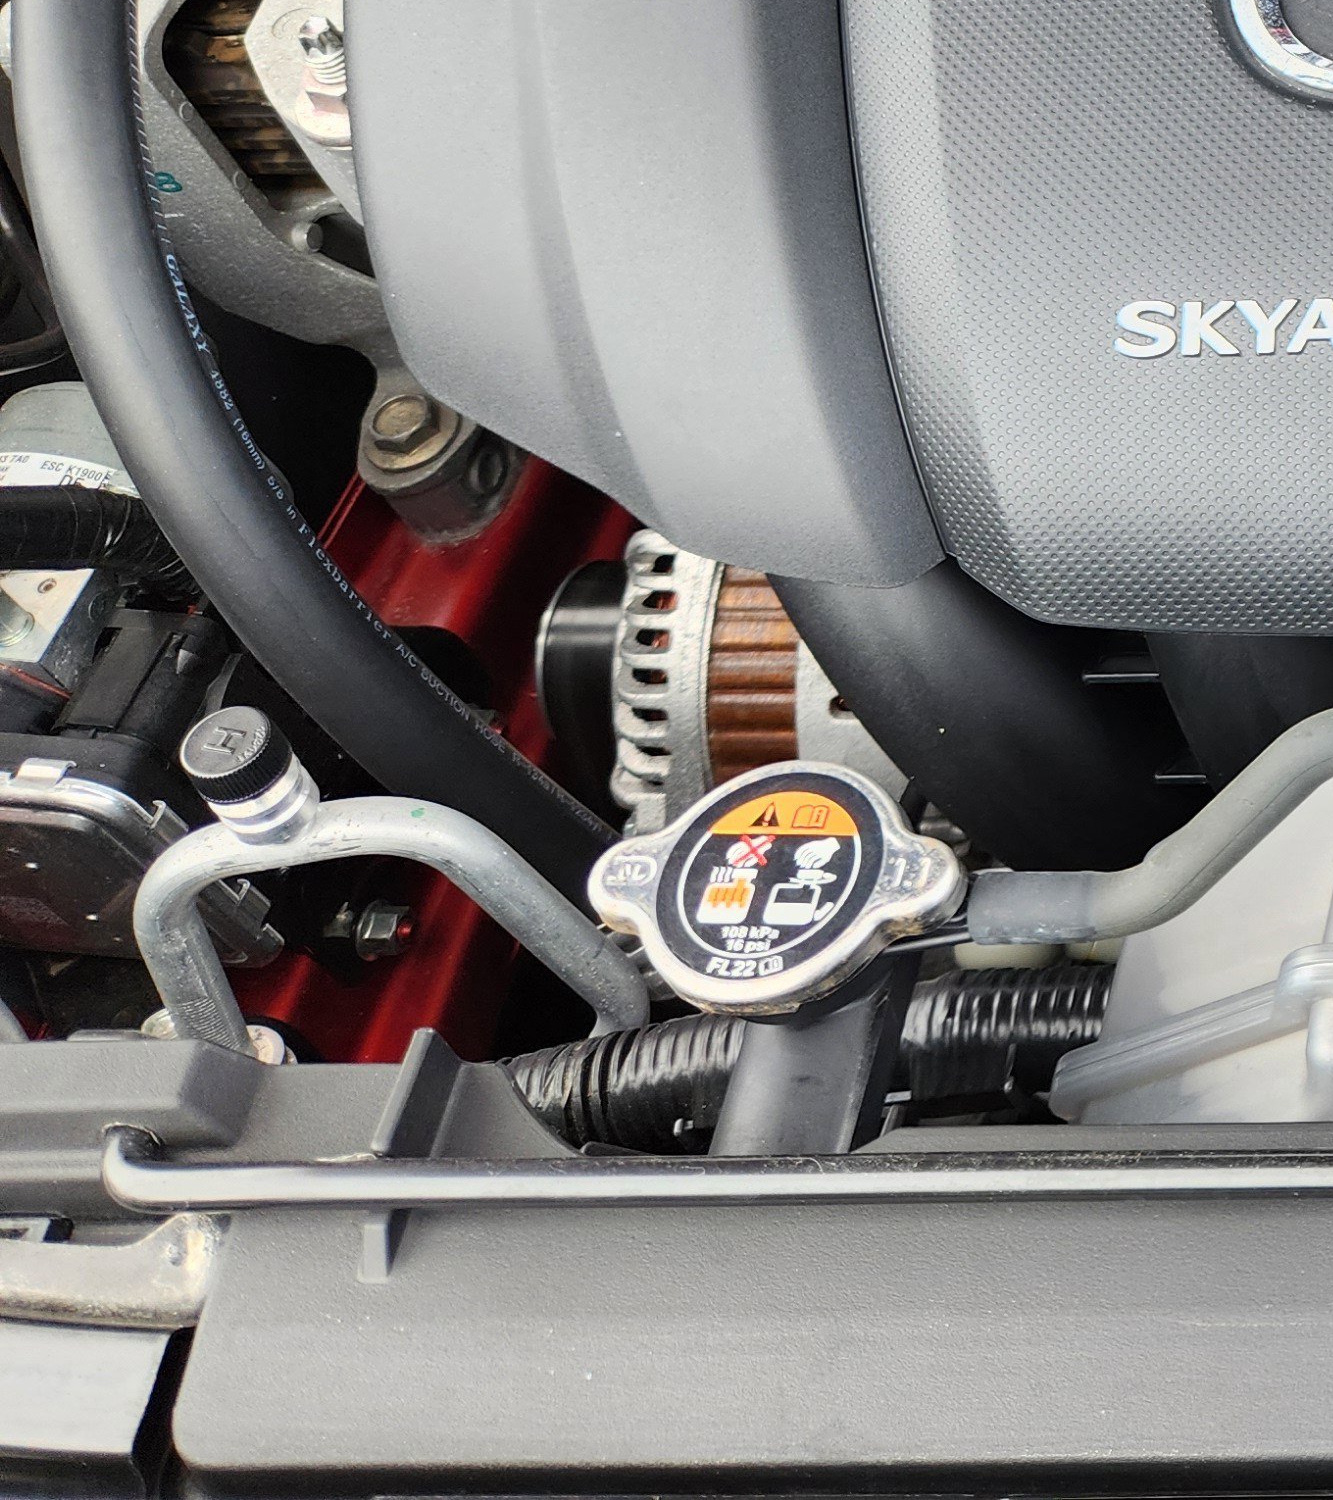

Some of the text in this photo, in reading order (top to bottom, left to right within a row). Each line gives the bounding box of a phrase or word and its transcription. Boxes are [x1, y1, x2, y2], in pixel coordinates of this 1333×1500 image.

[40, 461, 65, 472] ESC
[166, 254, 212, 355] GALAXY
[233, 418, 266, 470] (16mm)
[298, 522, 392, 640] Flexbarrier
[395, 643, 417, 668] A/C
[420, 667, 470, 721] SUCTION
[202, 727, 247, 754] H
[749, 926, 780, 940] kPa
[725, 938, 773, 954] 16 psi
[705, 956, 757, 977] FL22
